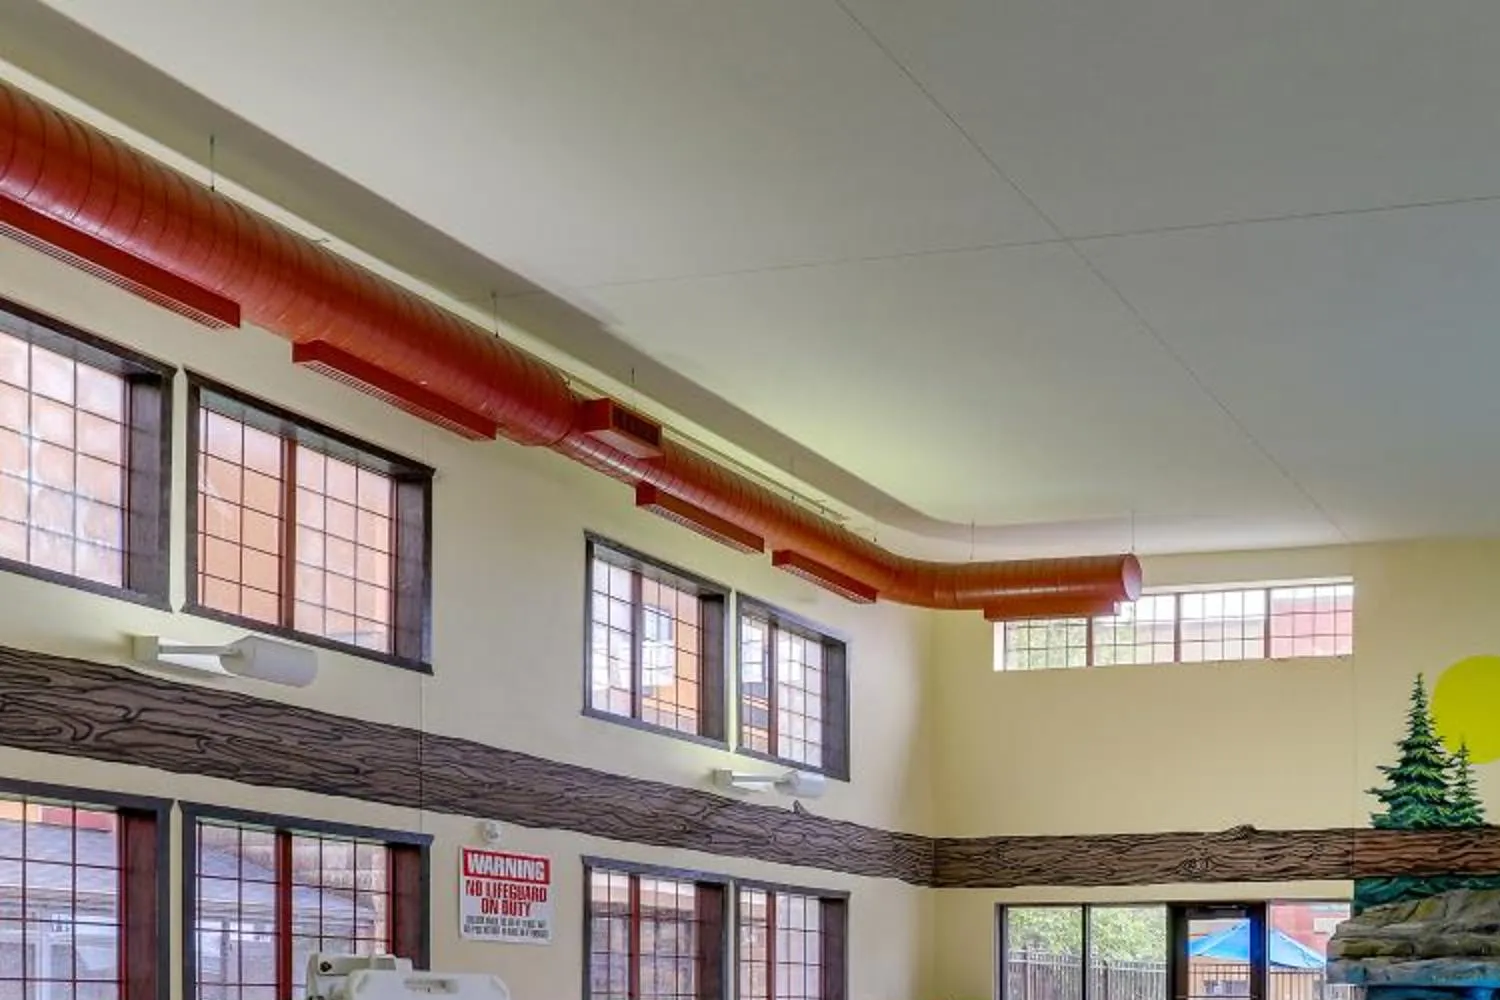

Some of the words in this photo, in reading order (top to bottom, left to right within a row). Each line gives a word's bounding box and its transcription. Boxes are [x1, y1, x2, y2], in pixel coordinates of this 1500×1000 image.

[467, 852, 545, 881] WARNING
[465, 880, 483, 897] NO
[486, 881, 547, 903] LIFEGUARD
[481, 898, 498, 914] ON
[501, 900, 531, 917] DUTY
